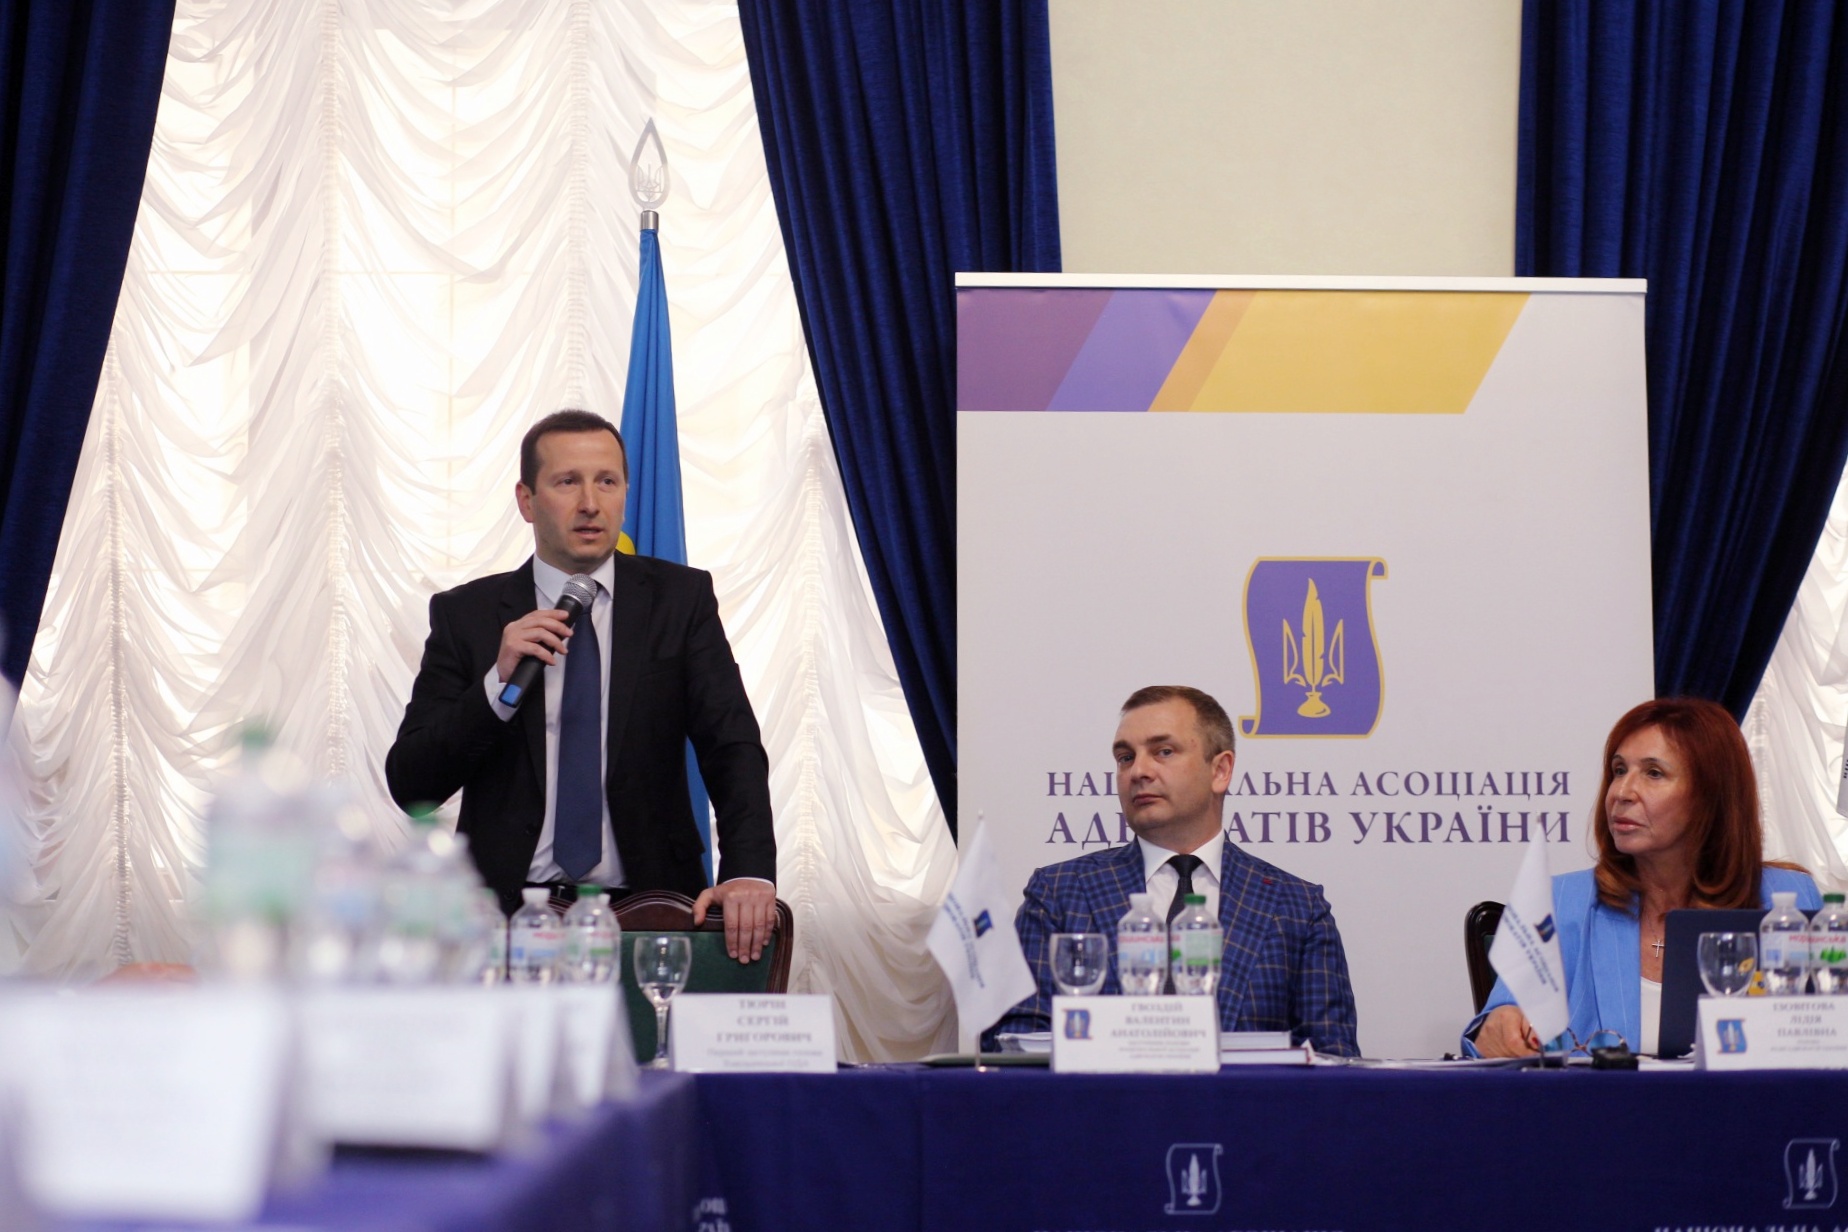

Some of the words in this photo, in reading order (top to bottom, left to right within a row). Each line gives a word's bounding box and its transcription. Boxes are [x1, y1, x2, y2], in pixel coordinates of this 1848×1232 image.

[1046, 771, 1339, 796] НАЦЛЬНА
[1350, 771, 1571, 801] АСОЦІАЦІЯ
[1045, 811, 1332, 850] АДАТІВ
[1348, 805, 1571, 845] УКРАЇНИ
